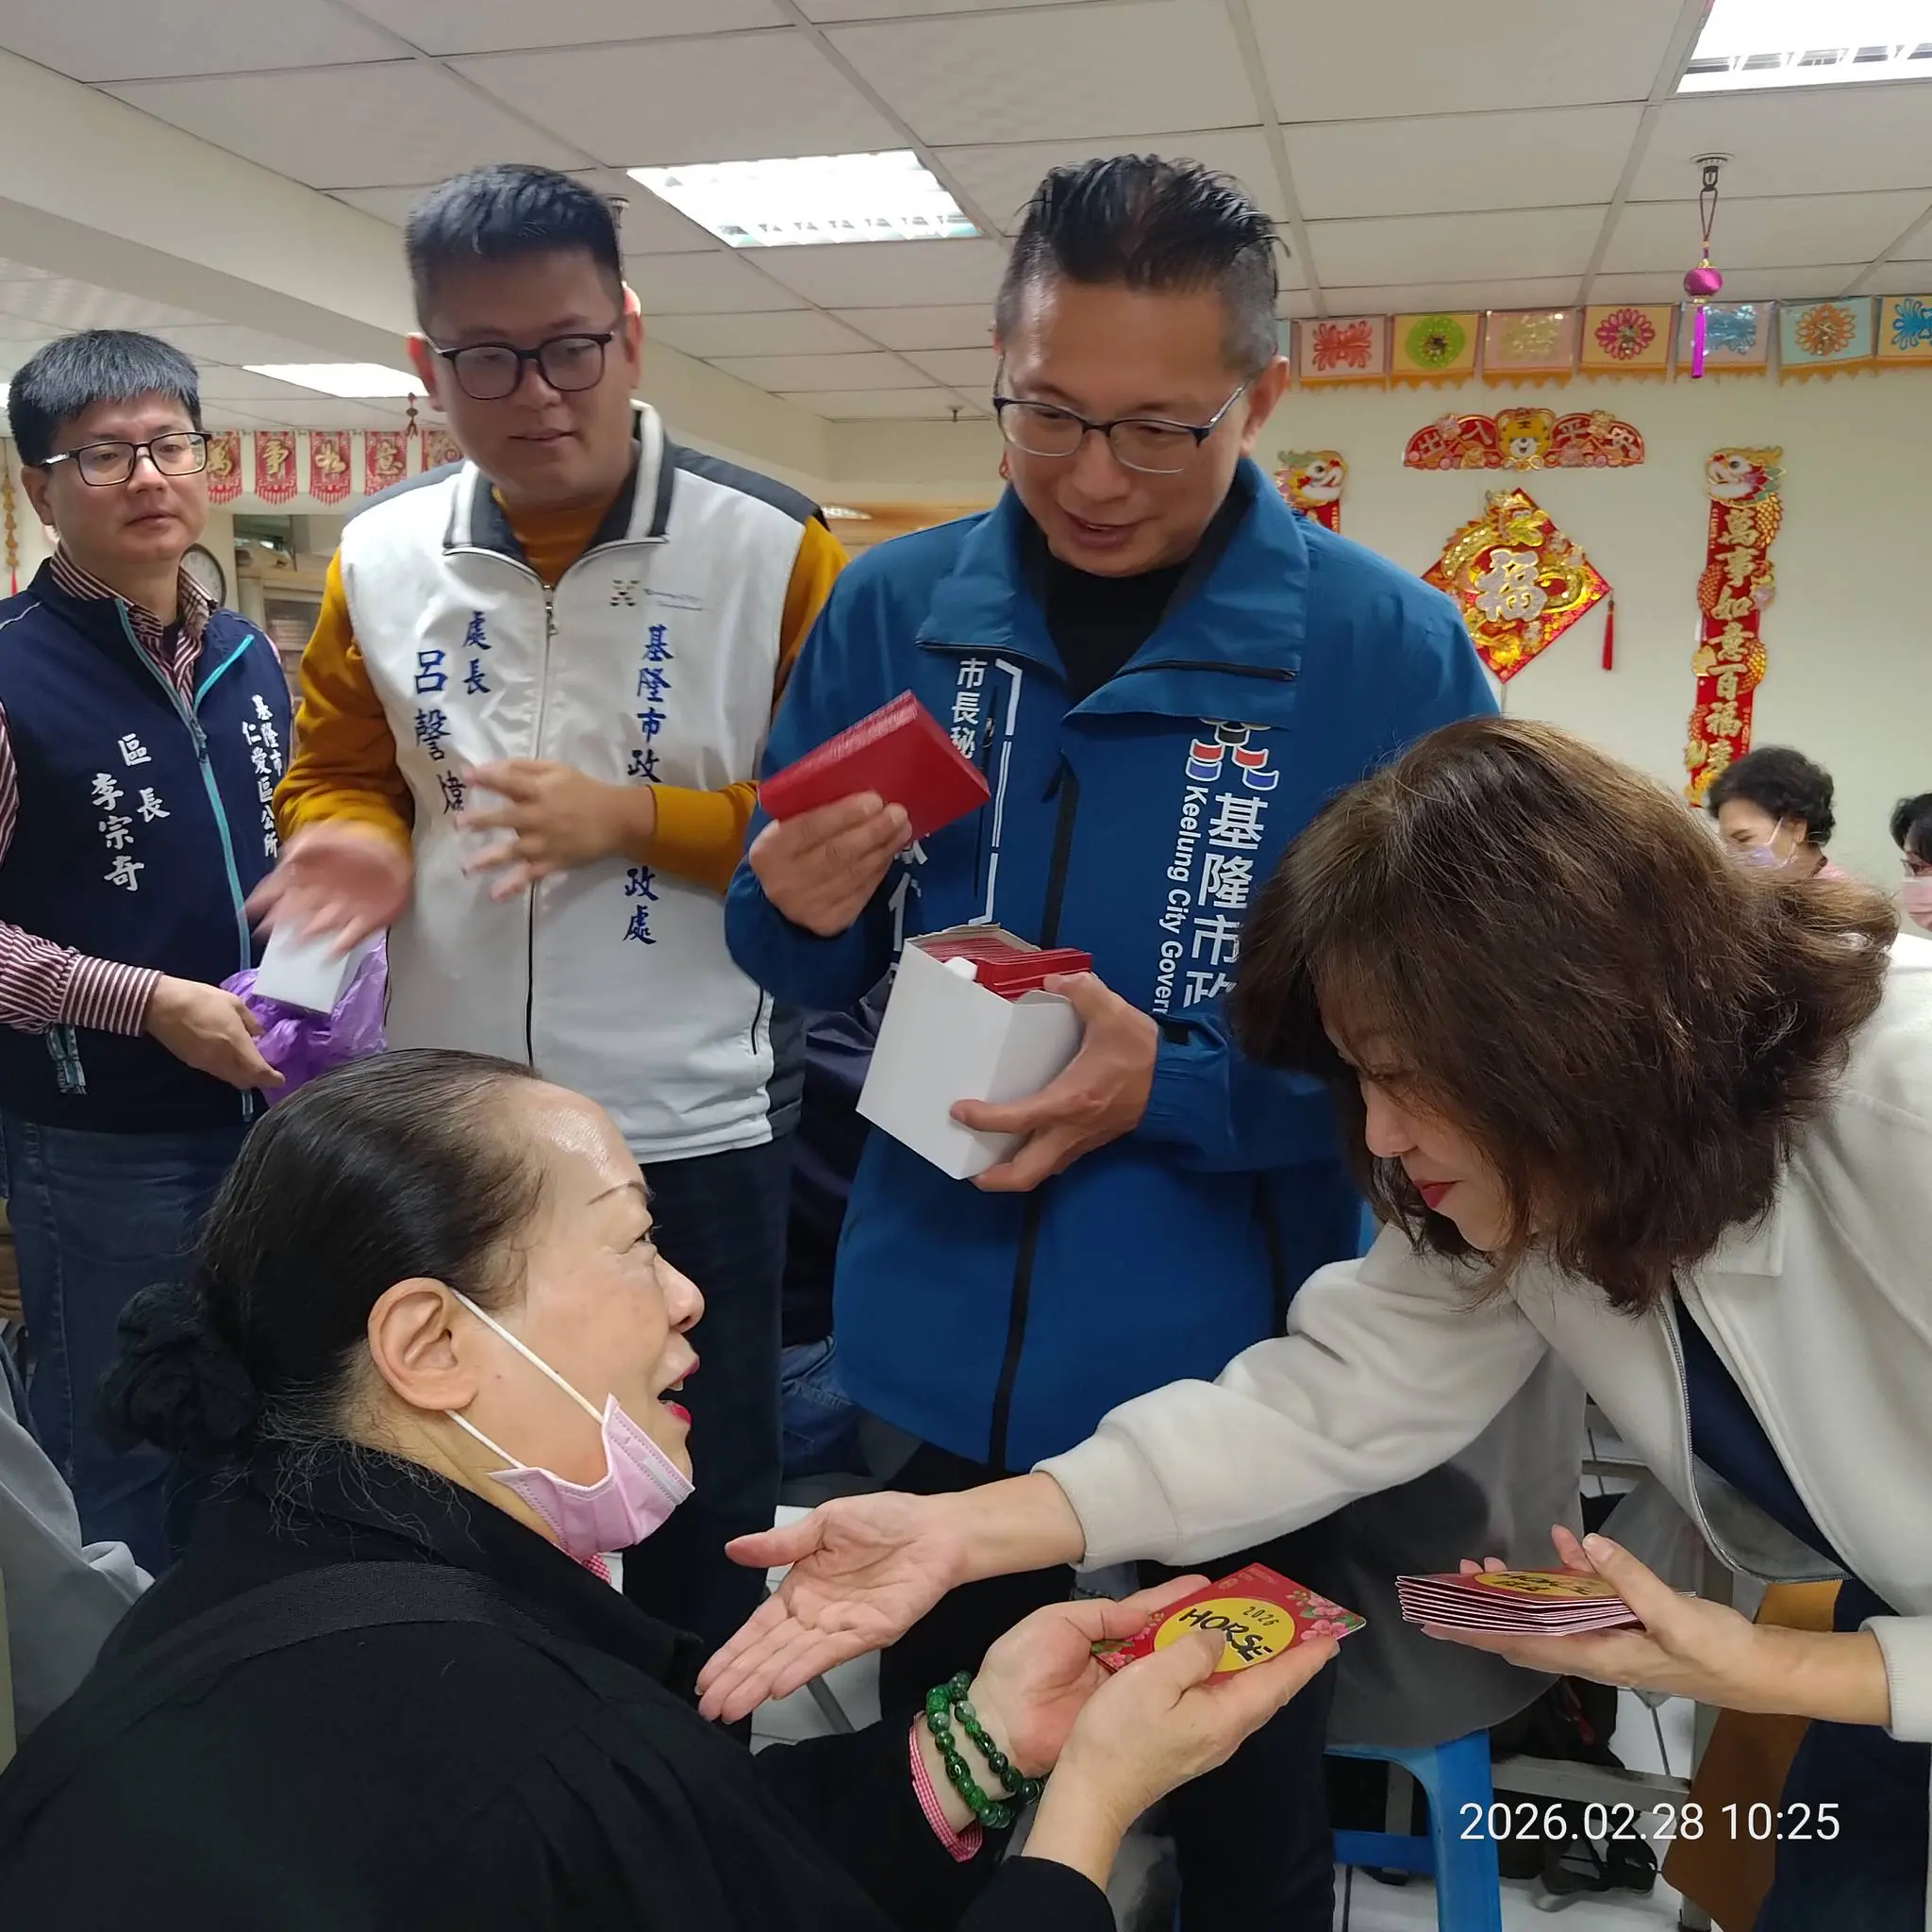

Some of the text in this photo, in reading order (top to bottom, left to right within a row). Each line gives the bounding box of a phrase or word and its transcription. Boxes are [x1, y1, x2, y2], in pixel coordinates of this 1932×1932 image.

[1474, 548, 1548, 623] 福
[460, 609, 492, 695] 處長
[251, 693, 283, 777] 基隆市
[117, 732, 171, 823] 區長
[242, 721, 279, 858] 仁愛區公所
[1166, 785, 1209, 882] Keelung
[1158, 889, 1191, 935] City
[1178, 1607, 1274, 1662] HORSE
[1242, 1606, 1280, 1627] 2026
